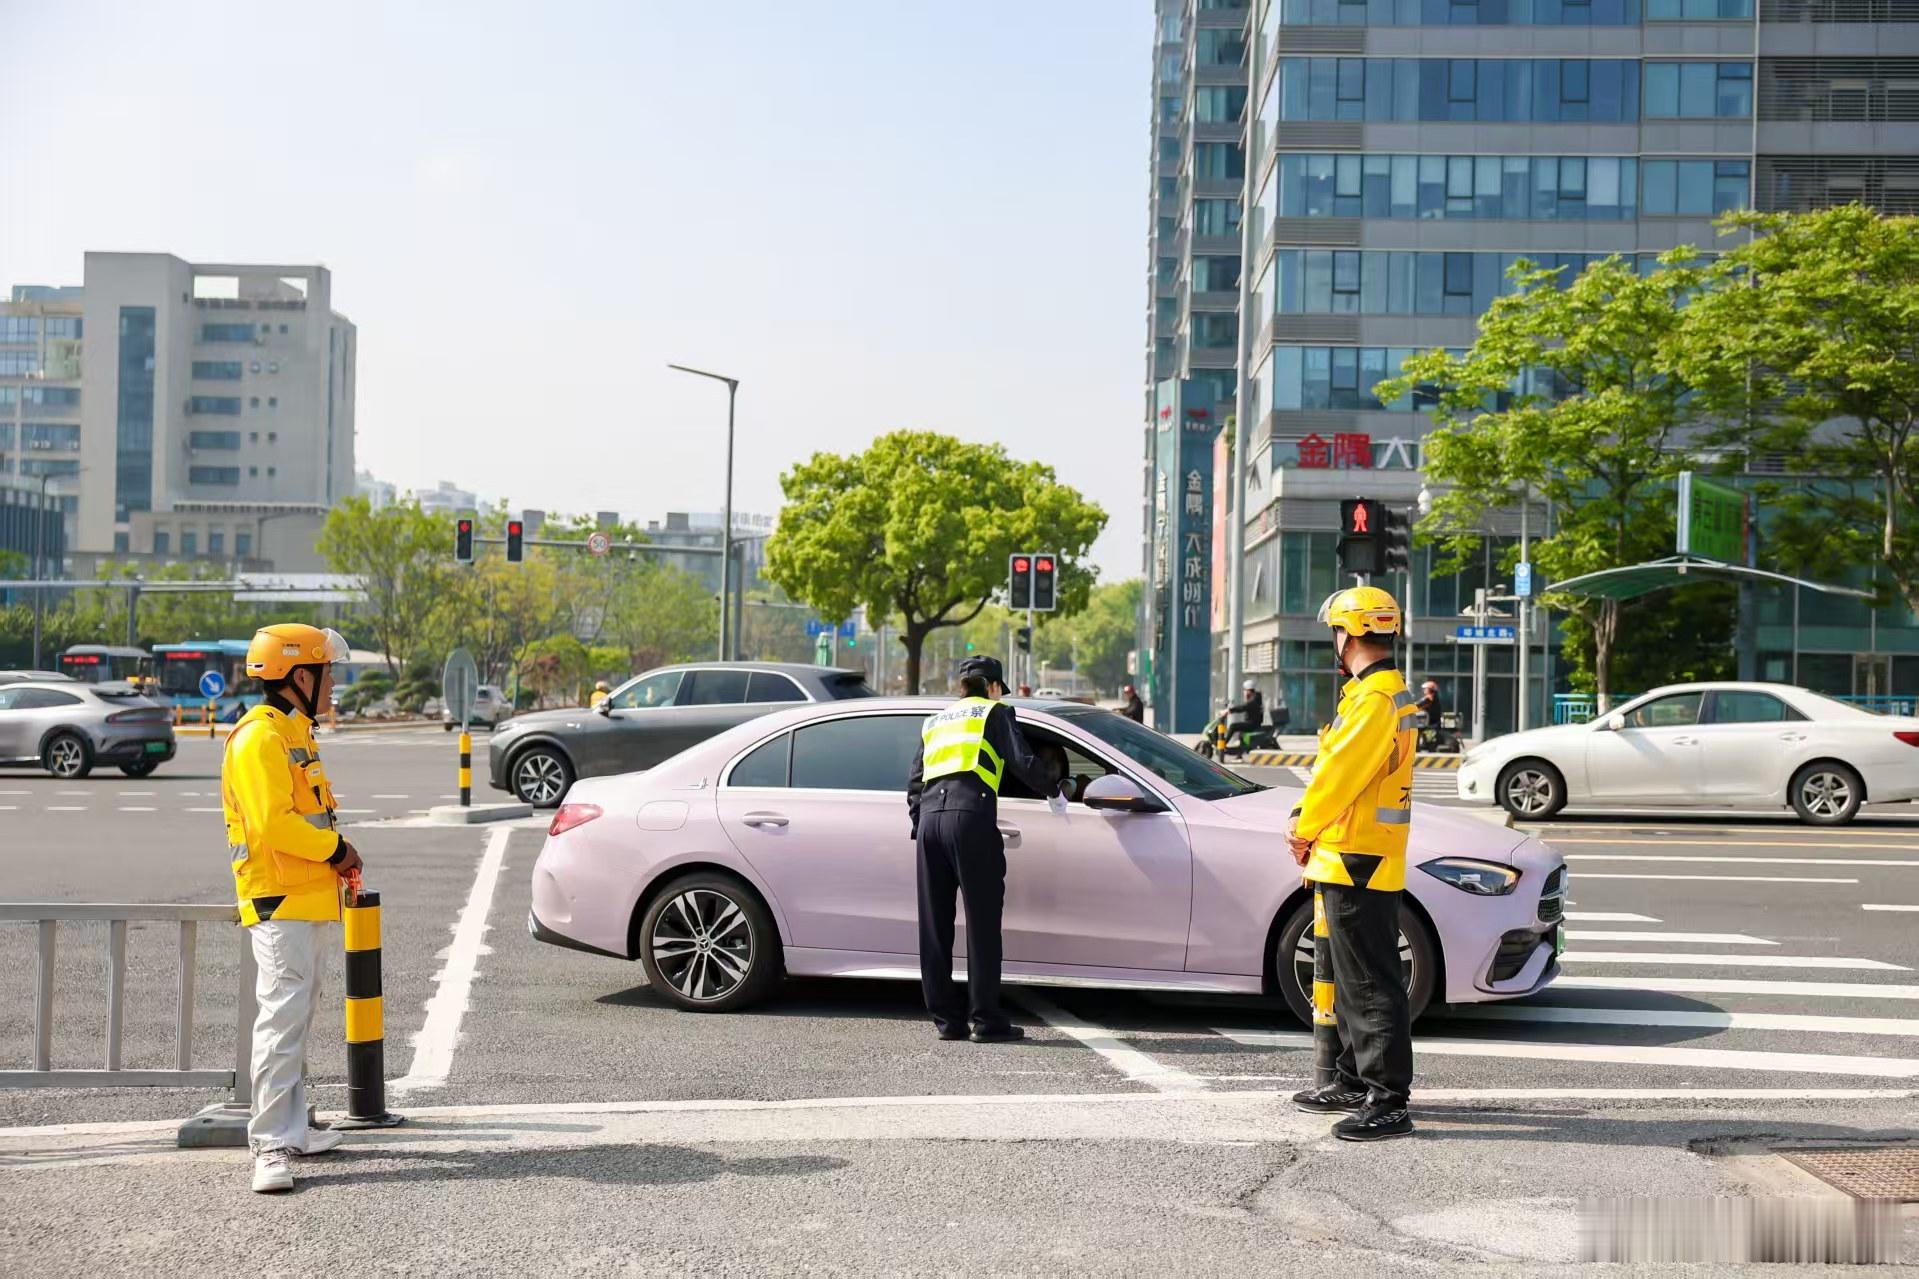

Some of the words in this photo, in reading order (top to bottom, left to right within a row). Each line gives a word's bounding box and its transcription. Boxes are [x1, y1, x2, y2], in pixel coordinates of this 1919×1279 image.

[1296, 432, 1424, 469] 金隅大
[594, 538, 606, 550] 50
[940, 709, 968, 720] POLICE
[971, 705, 986, 718] 察
